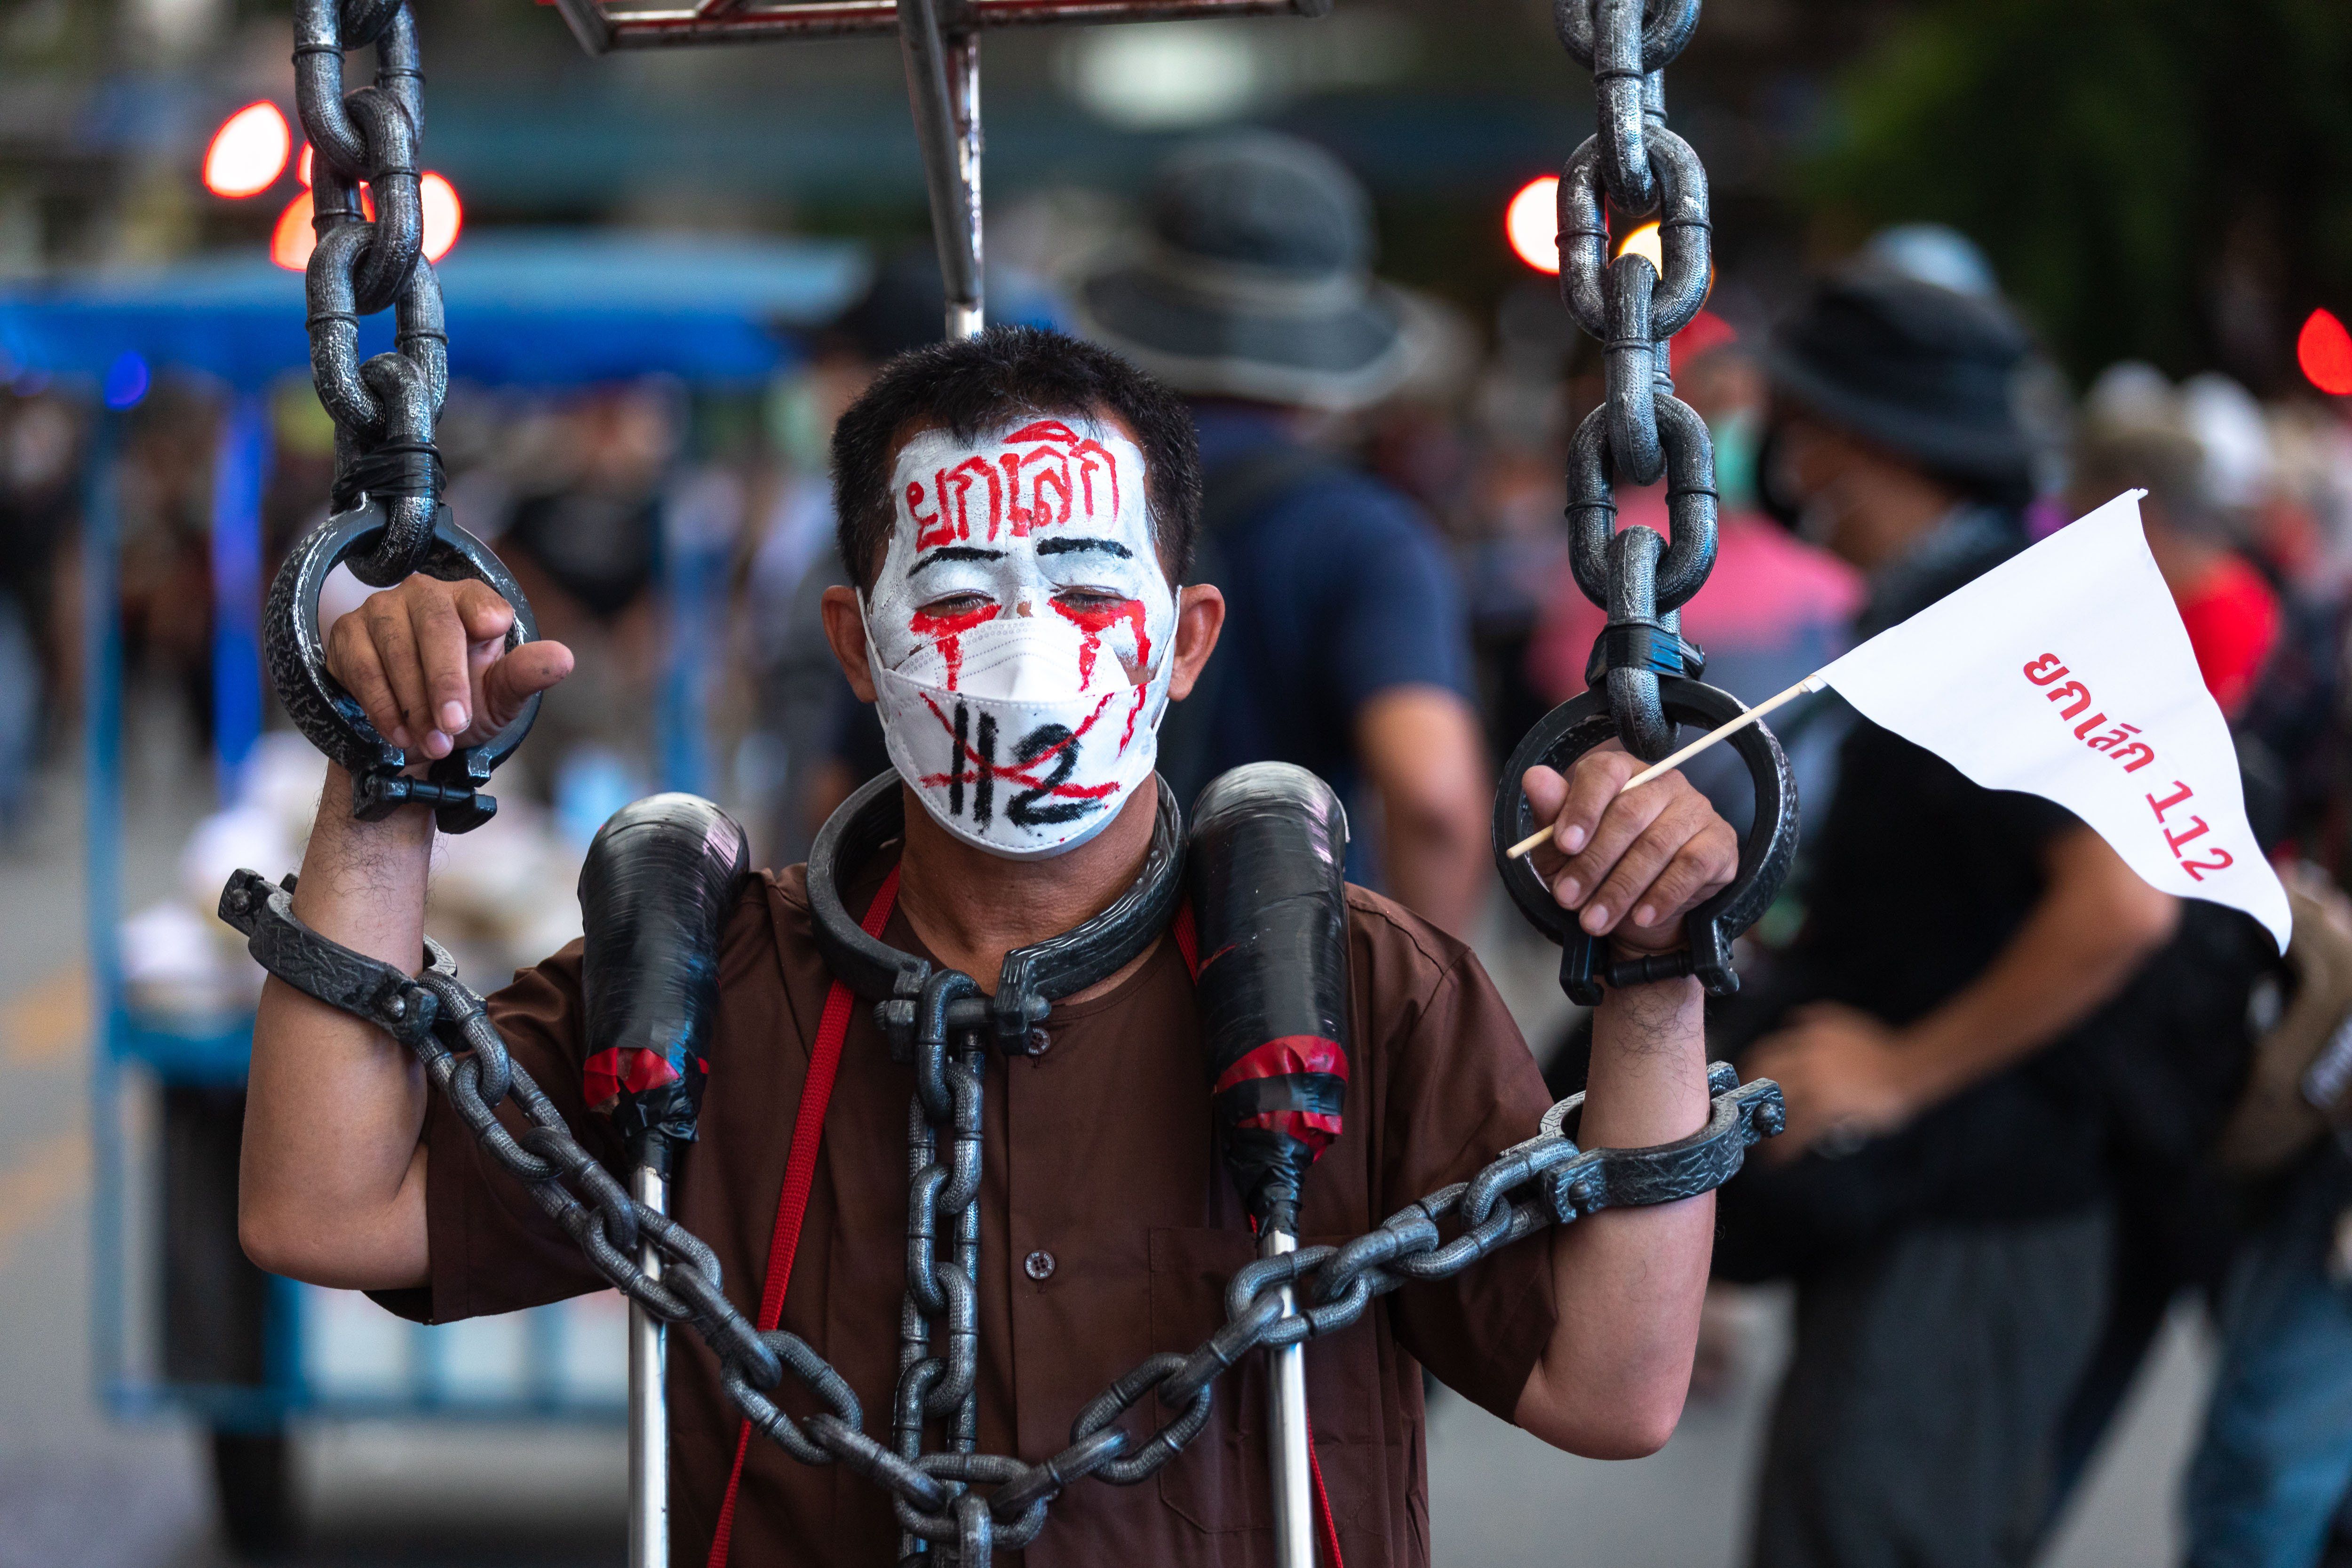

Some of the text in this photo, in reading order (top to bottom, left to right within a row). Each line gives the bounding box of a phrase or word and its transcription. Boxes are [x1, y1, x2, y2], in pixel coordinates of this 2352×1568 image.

[906, 420, 1120, 553] ยกเลิก
[949, 695, 1104, 833] 112
[2023, 653, 2233, 882] ยกเลิก 112
